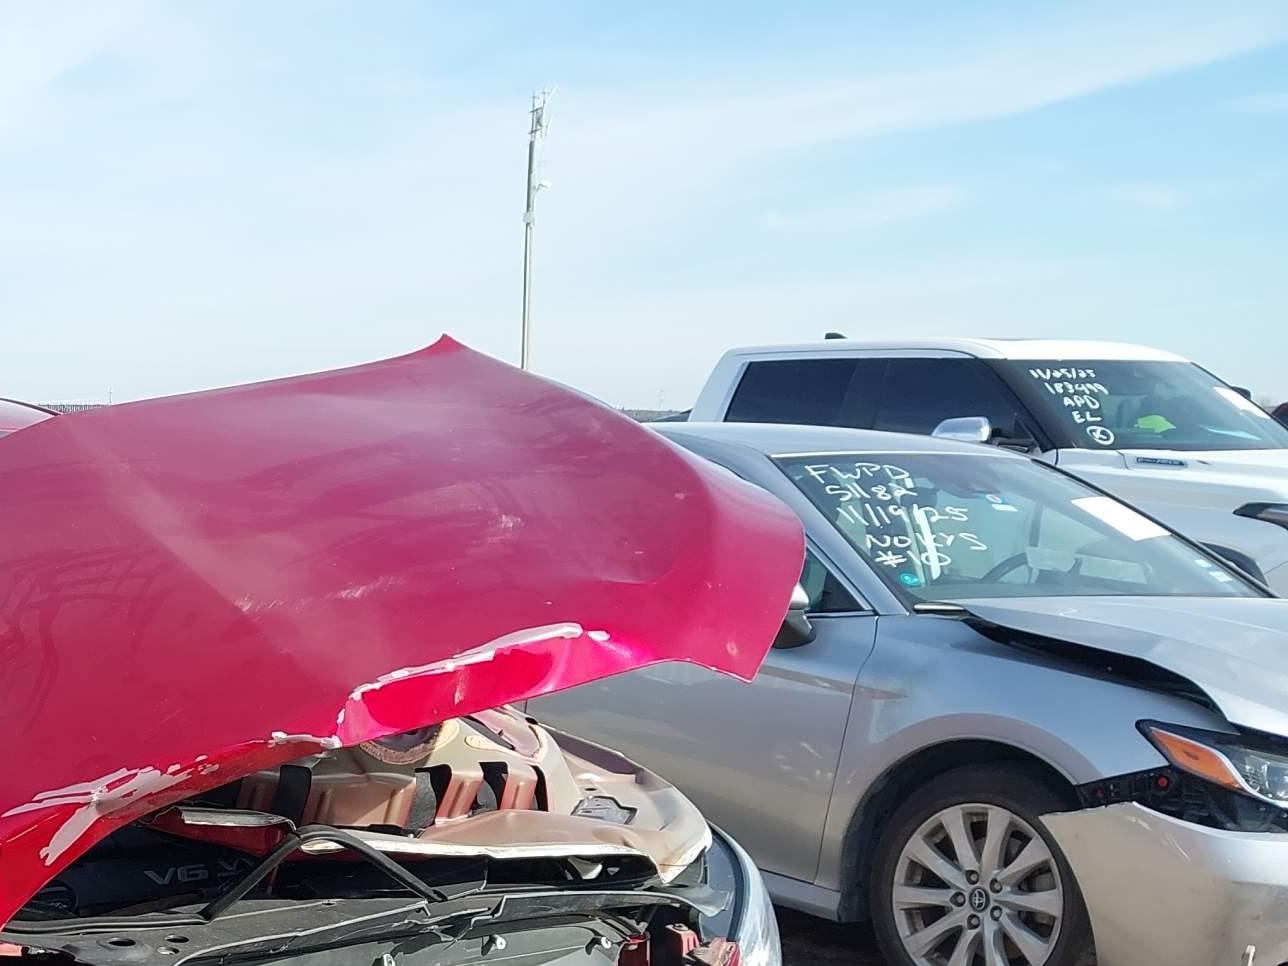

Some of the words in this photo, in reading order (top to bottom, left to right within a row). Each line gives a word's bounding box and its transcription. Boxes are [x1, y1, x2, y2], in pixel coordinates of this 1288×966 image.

[1063, 394, 1100, 410] APD
[1071, 410, 1102, 424] EL
[804, 462, 910, 484] FWPD
[143, 863, 209, 886] V6
